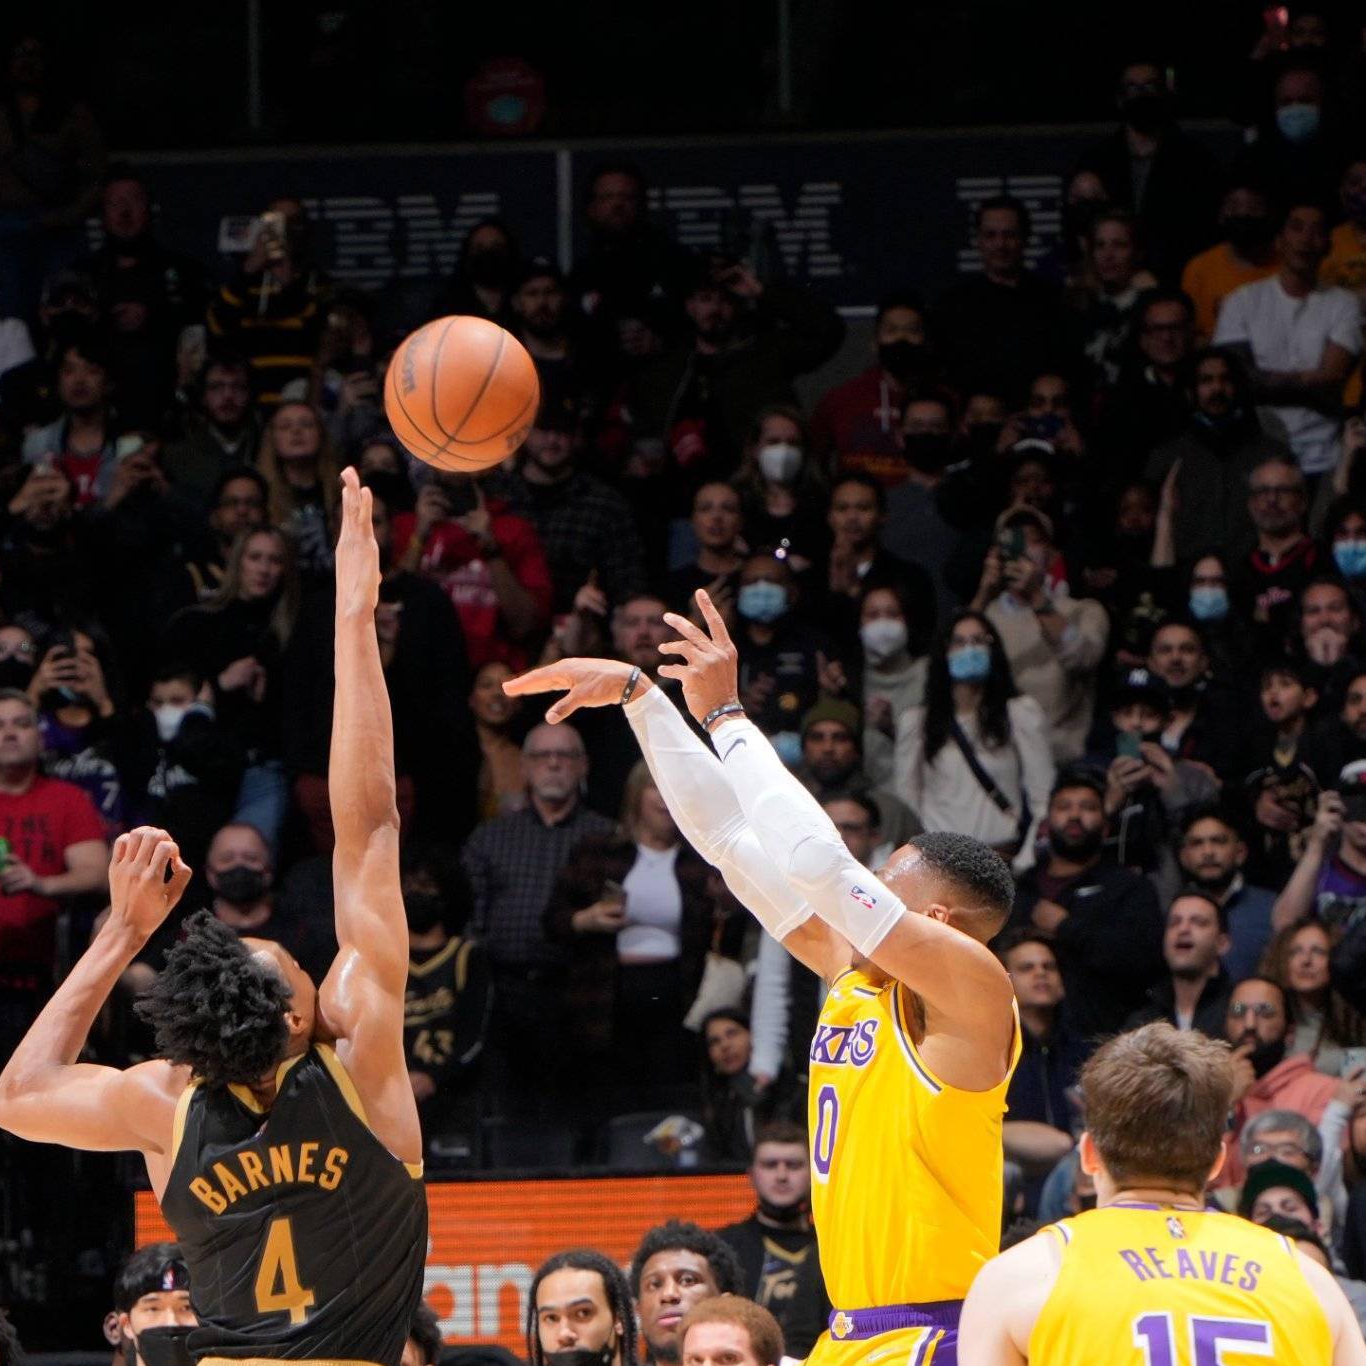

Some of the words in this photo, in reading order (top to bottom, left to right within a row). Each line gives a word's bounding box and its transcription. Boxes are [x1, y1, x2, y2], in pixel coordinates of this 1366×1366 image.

[302, 192, 501, 290] BM
[646, 182, 844, 276] BM
[189, 1138, 349, 1216] BARNES
[254, 1216, 315, 1326] 4
[1118, 1246, 1263, 1292] REAVES
